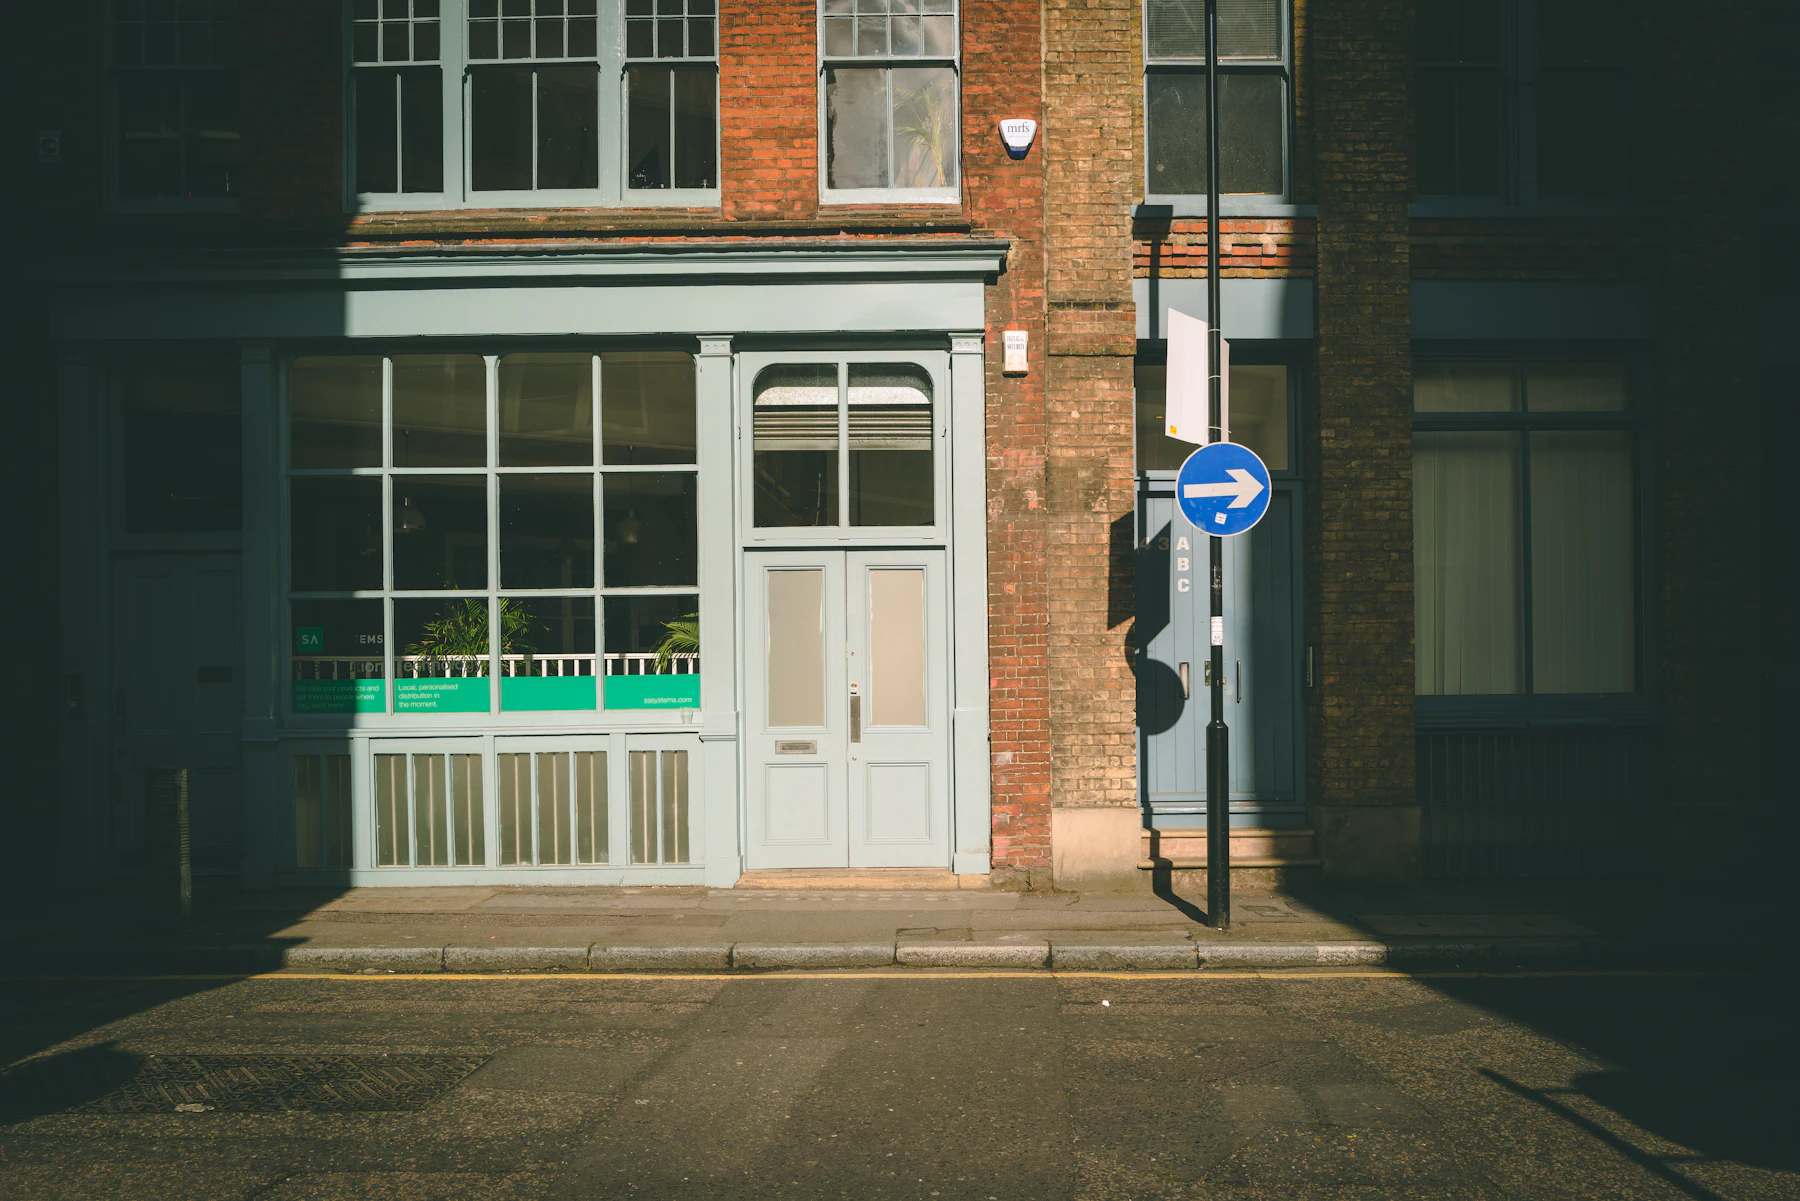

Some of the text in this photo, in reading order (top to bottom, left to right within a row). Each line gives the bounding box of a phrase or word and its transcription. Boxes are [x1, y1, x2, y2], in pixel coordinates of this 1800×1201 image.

[1007, 121, 1030, 133] mrfs
[418, 684, 459, 692] personalised
[643, 697, 693, 705] sasystems.com
